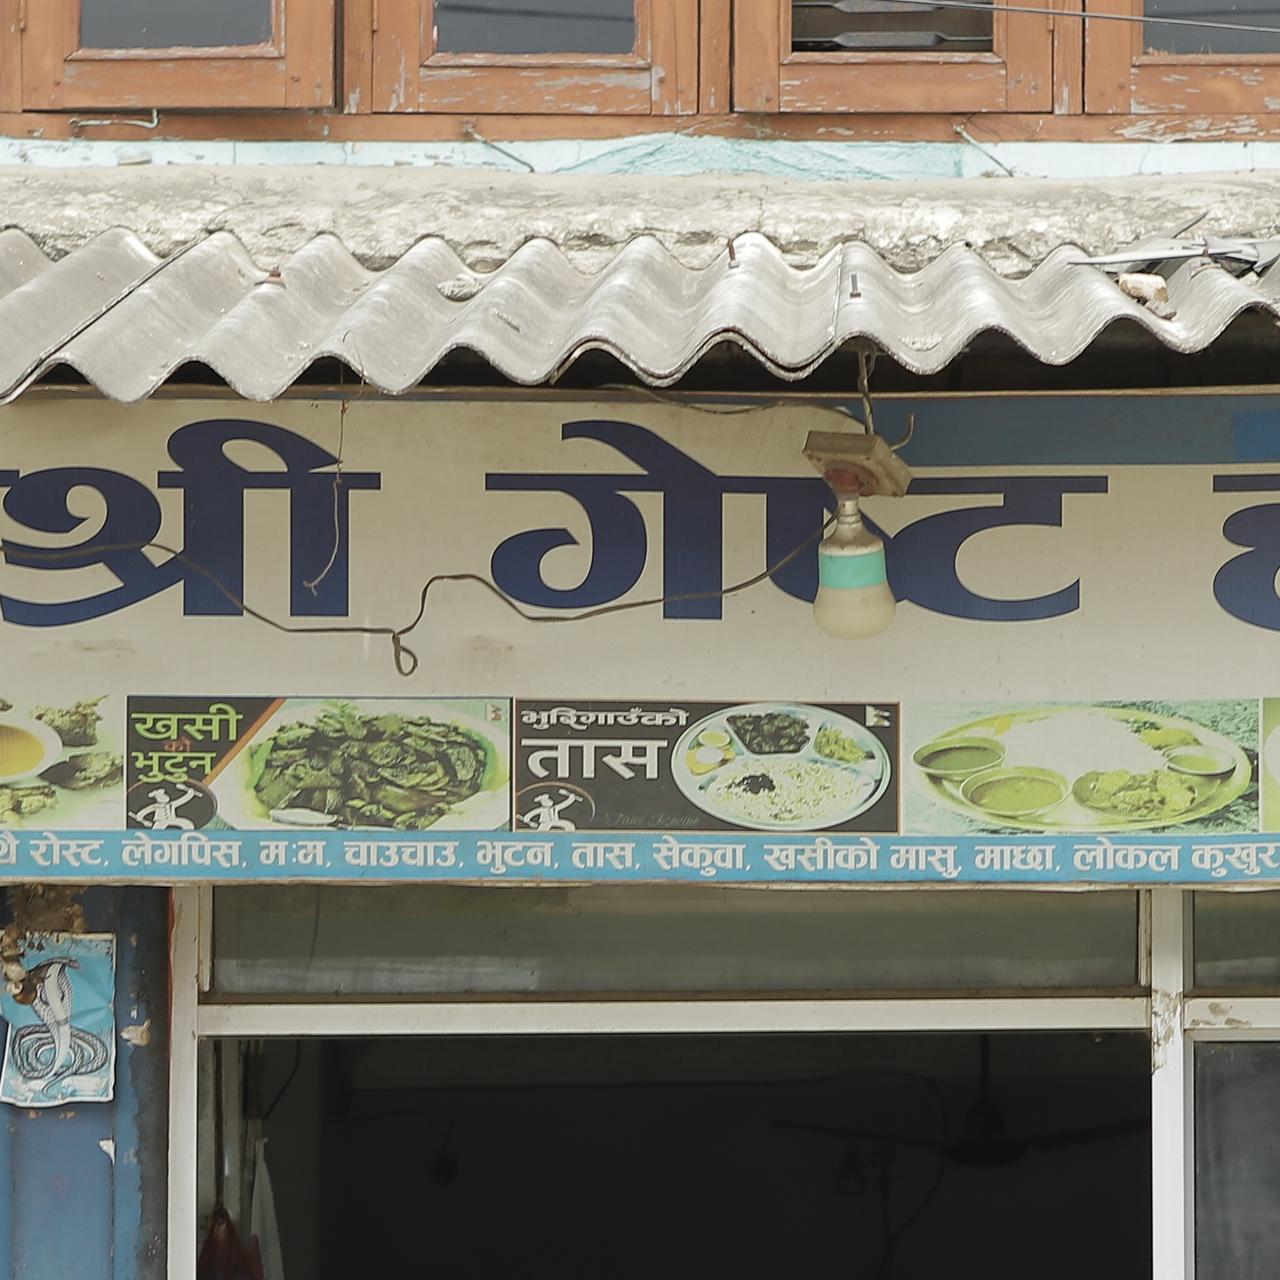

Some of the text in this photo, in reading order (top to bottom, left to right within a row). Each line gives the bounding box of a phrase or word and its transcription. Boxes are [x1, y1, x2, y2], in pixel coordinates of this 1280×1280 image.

[131, 703, 244, 740] खसी
[521, 738, 669, 780] तास
[571, 842, 641, 871] तास,
[652, 835, 752, 877] सेकुवा,
[763, 837, 881, 873] खसीको
[1072, 836, 1182, 872] लोकल
